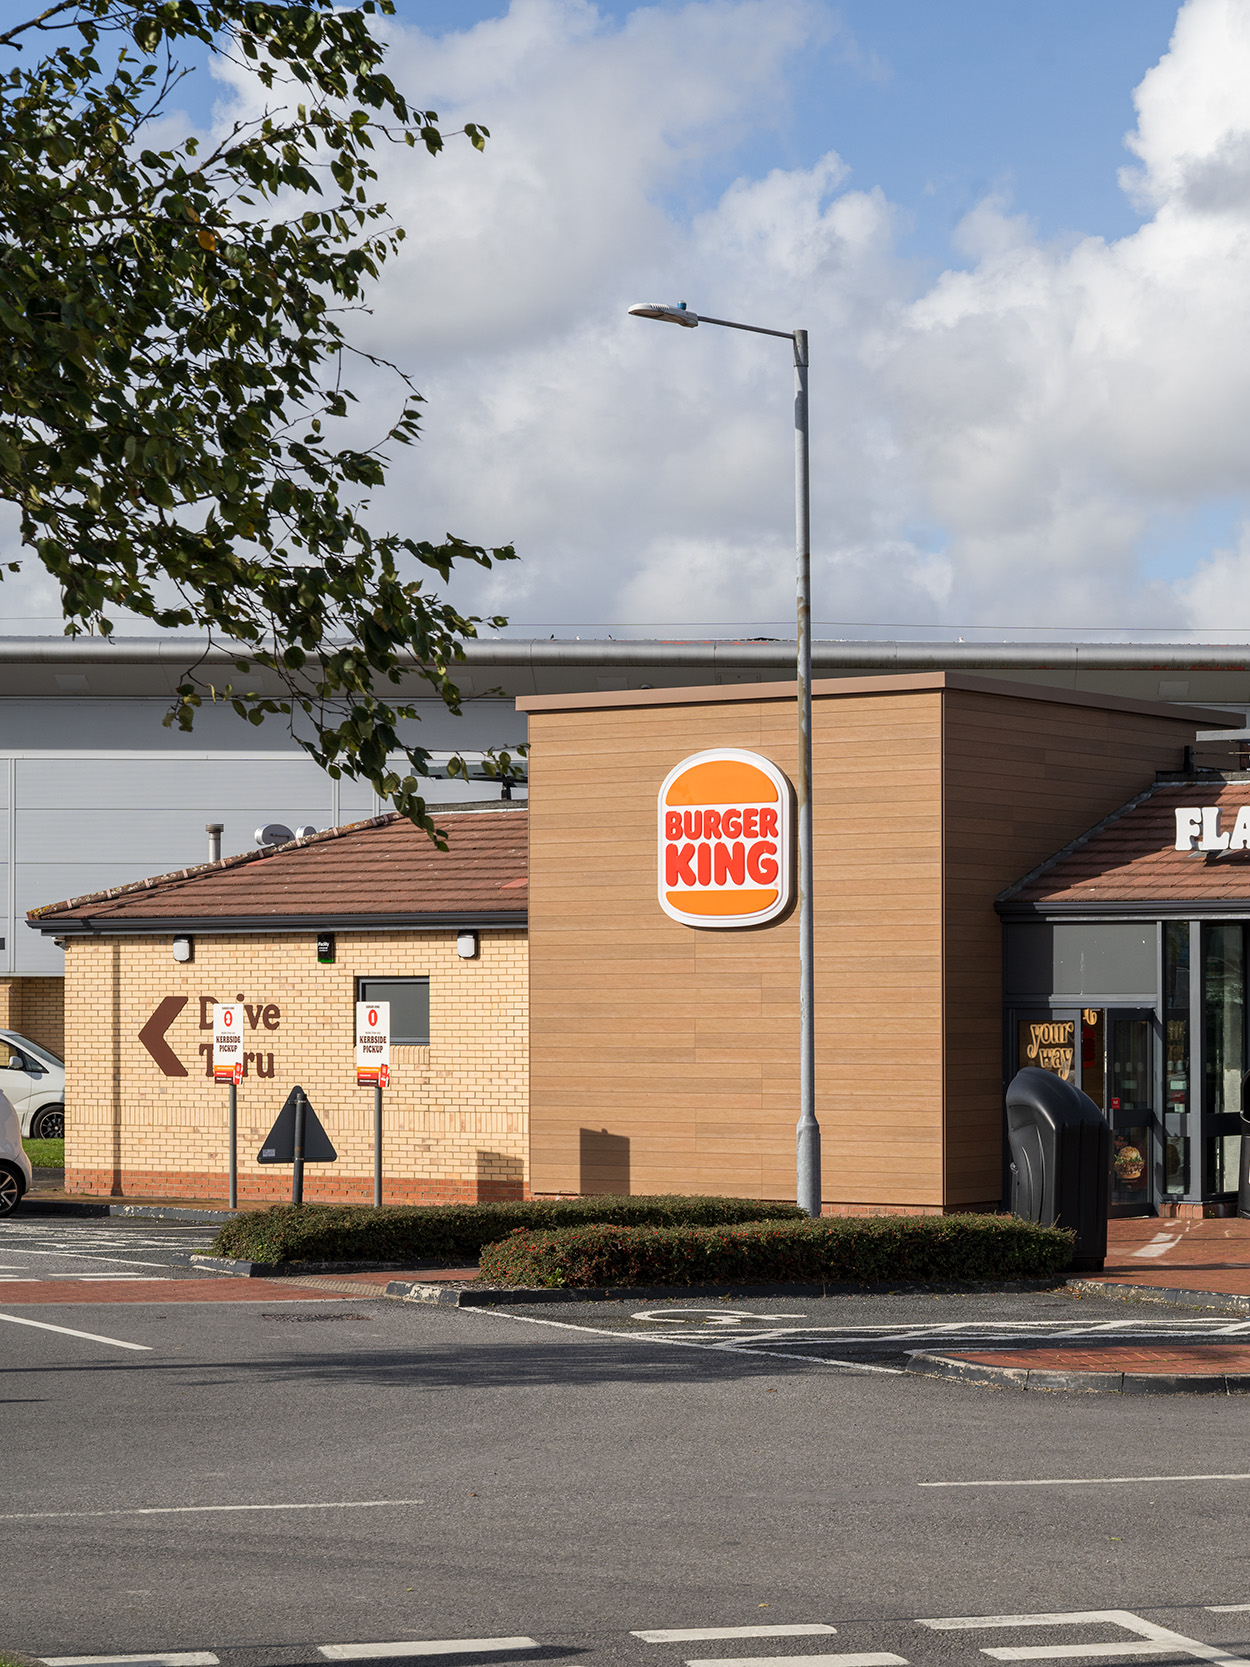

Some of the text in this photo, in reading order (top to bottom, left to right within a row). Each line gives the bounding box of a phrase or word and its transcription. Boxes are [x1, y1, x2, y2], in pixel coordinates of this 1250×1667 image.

[665, 808, 778, 841] BURGER
[665, 840, 779, 887] KING
[362, 1045, 384, 1053] PICKUP
[1027, 1022, 1074, 1058] your
[1039, 1047, 1073, 1080] way
